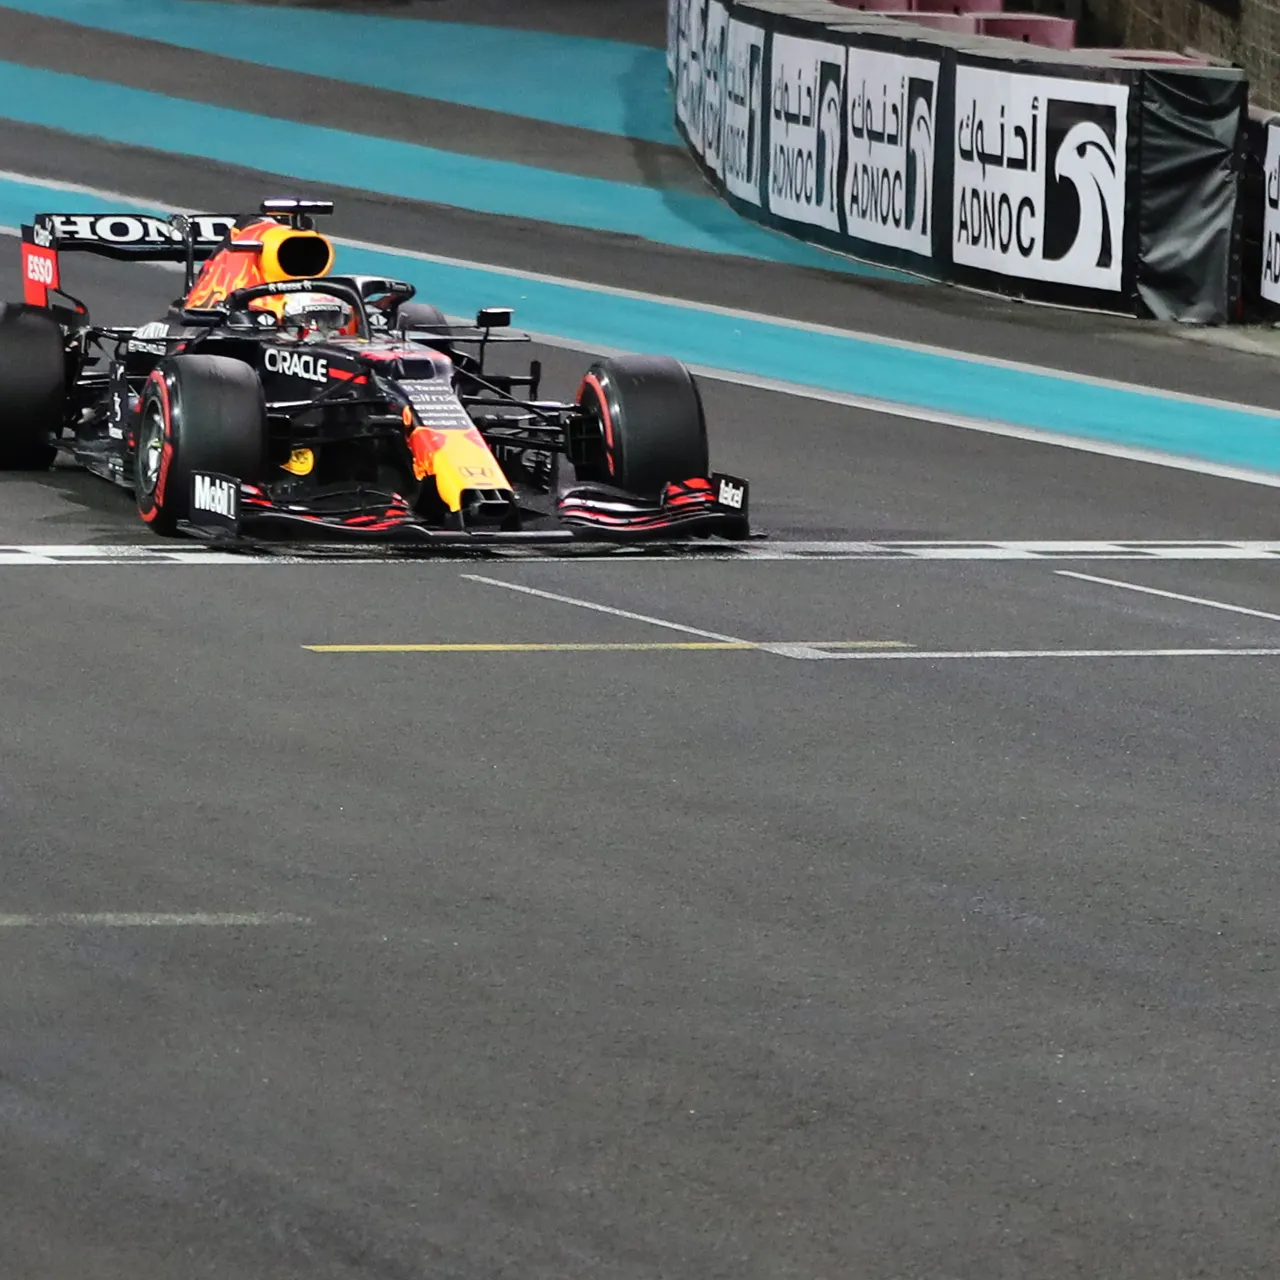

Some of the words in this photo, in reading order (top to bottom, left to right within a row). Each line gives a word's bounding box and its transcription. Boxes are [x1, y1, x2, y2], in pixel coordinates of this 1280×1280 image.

[772, 146, 815, 207] ADNOC
[850, 166, 904, 228] ADNOC
[53, 216, 237, 243] HOND
[957, 185, 1039, 257] ADNOC
[28, 253, 53, 285] ESSO
[264, 348, 328, 384] ORACLE
[193, 474, 228, 517] Mobil
